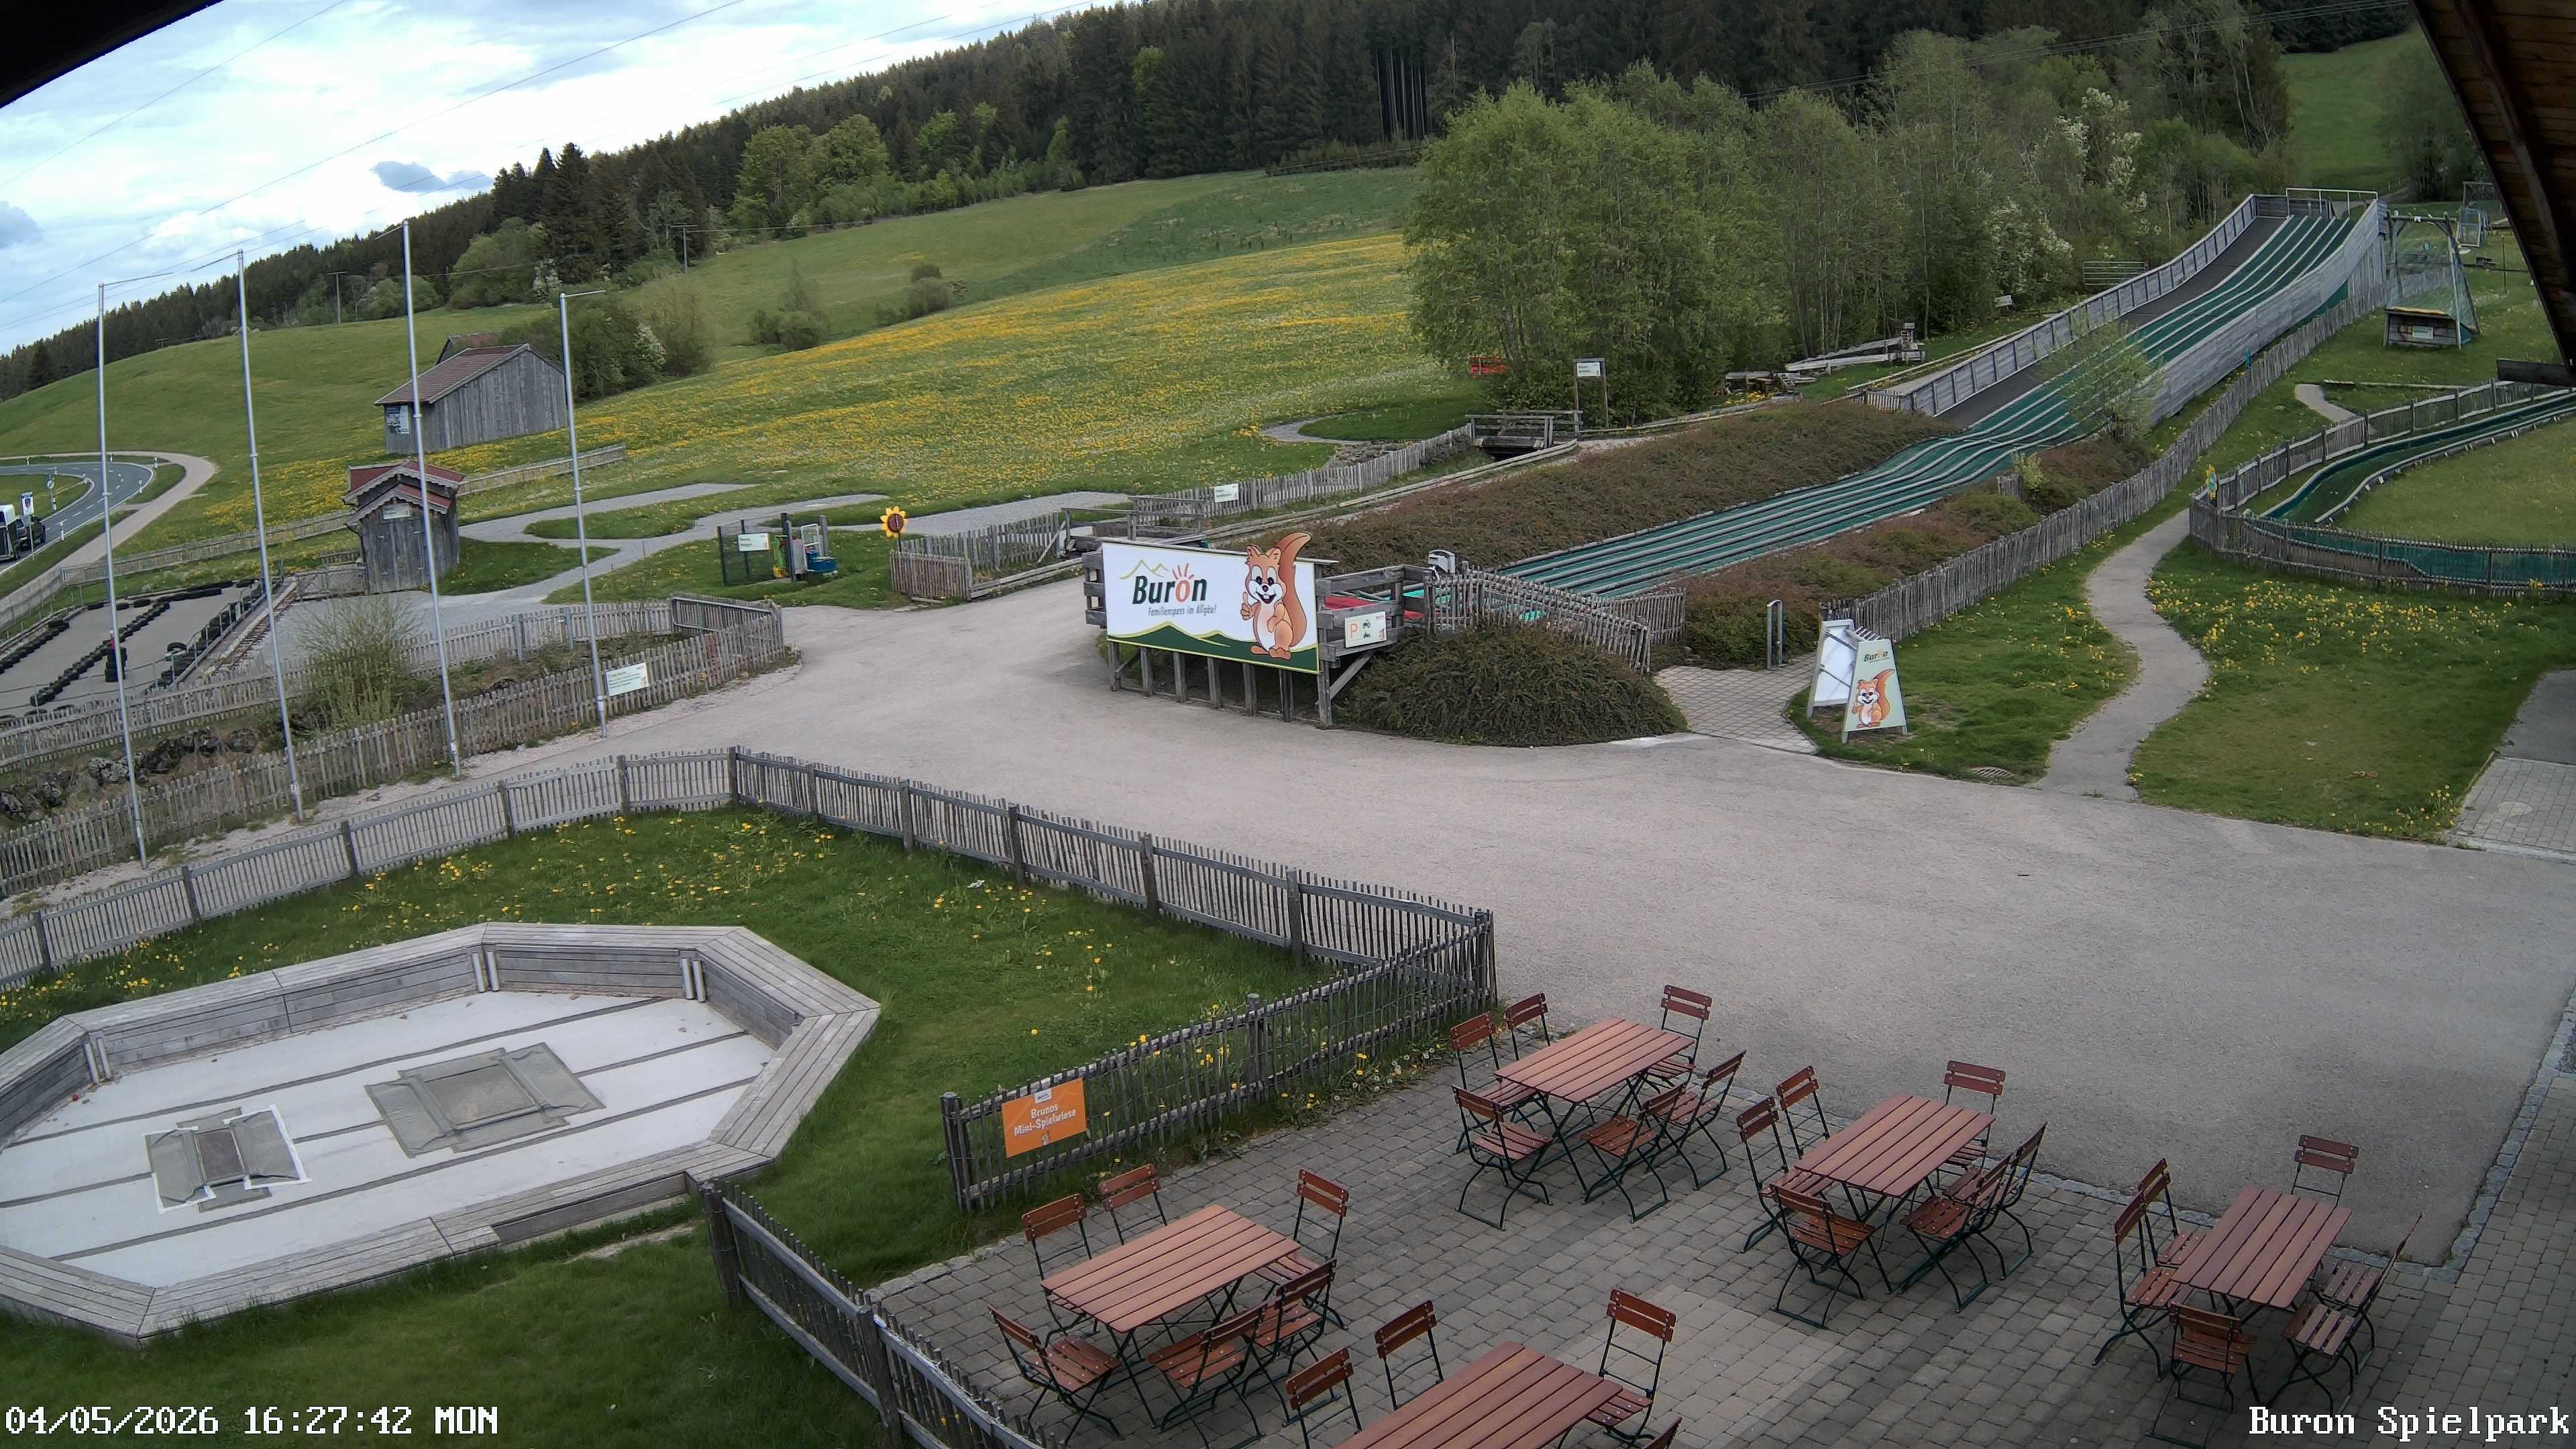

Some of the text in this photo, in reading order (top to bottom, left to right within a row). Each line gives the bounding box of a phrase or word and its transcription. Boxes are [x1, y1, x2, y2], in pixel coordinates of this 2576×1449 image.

[1132, 575, 1208, 604] Buron
[1350, 623, 1358, 639] P
[1030, 1104, 1059, 1119] Brunos
